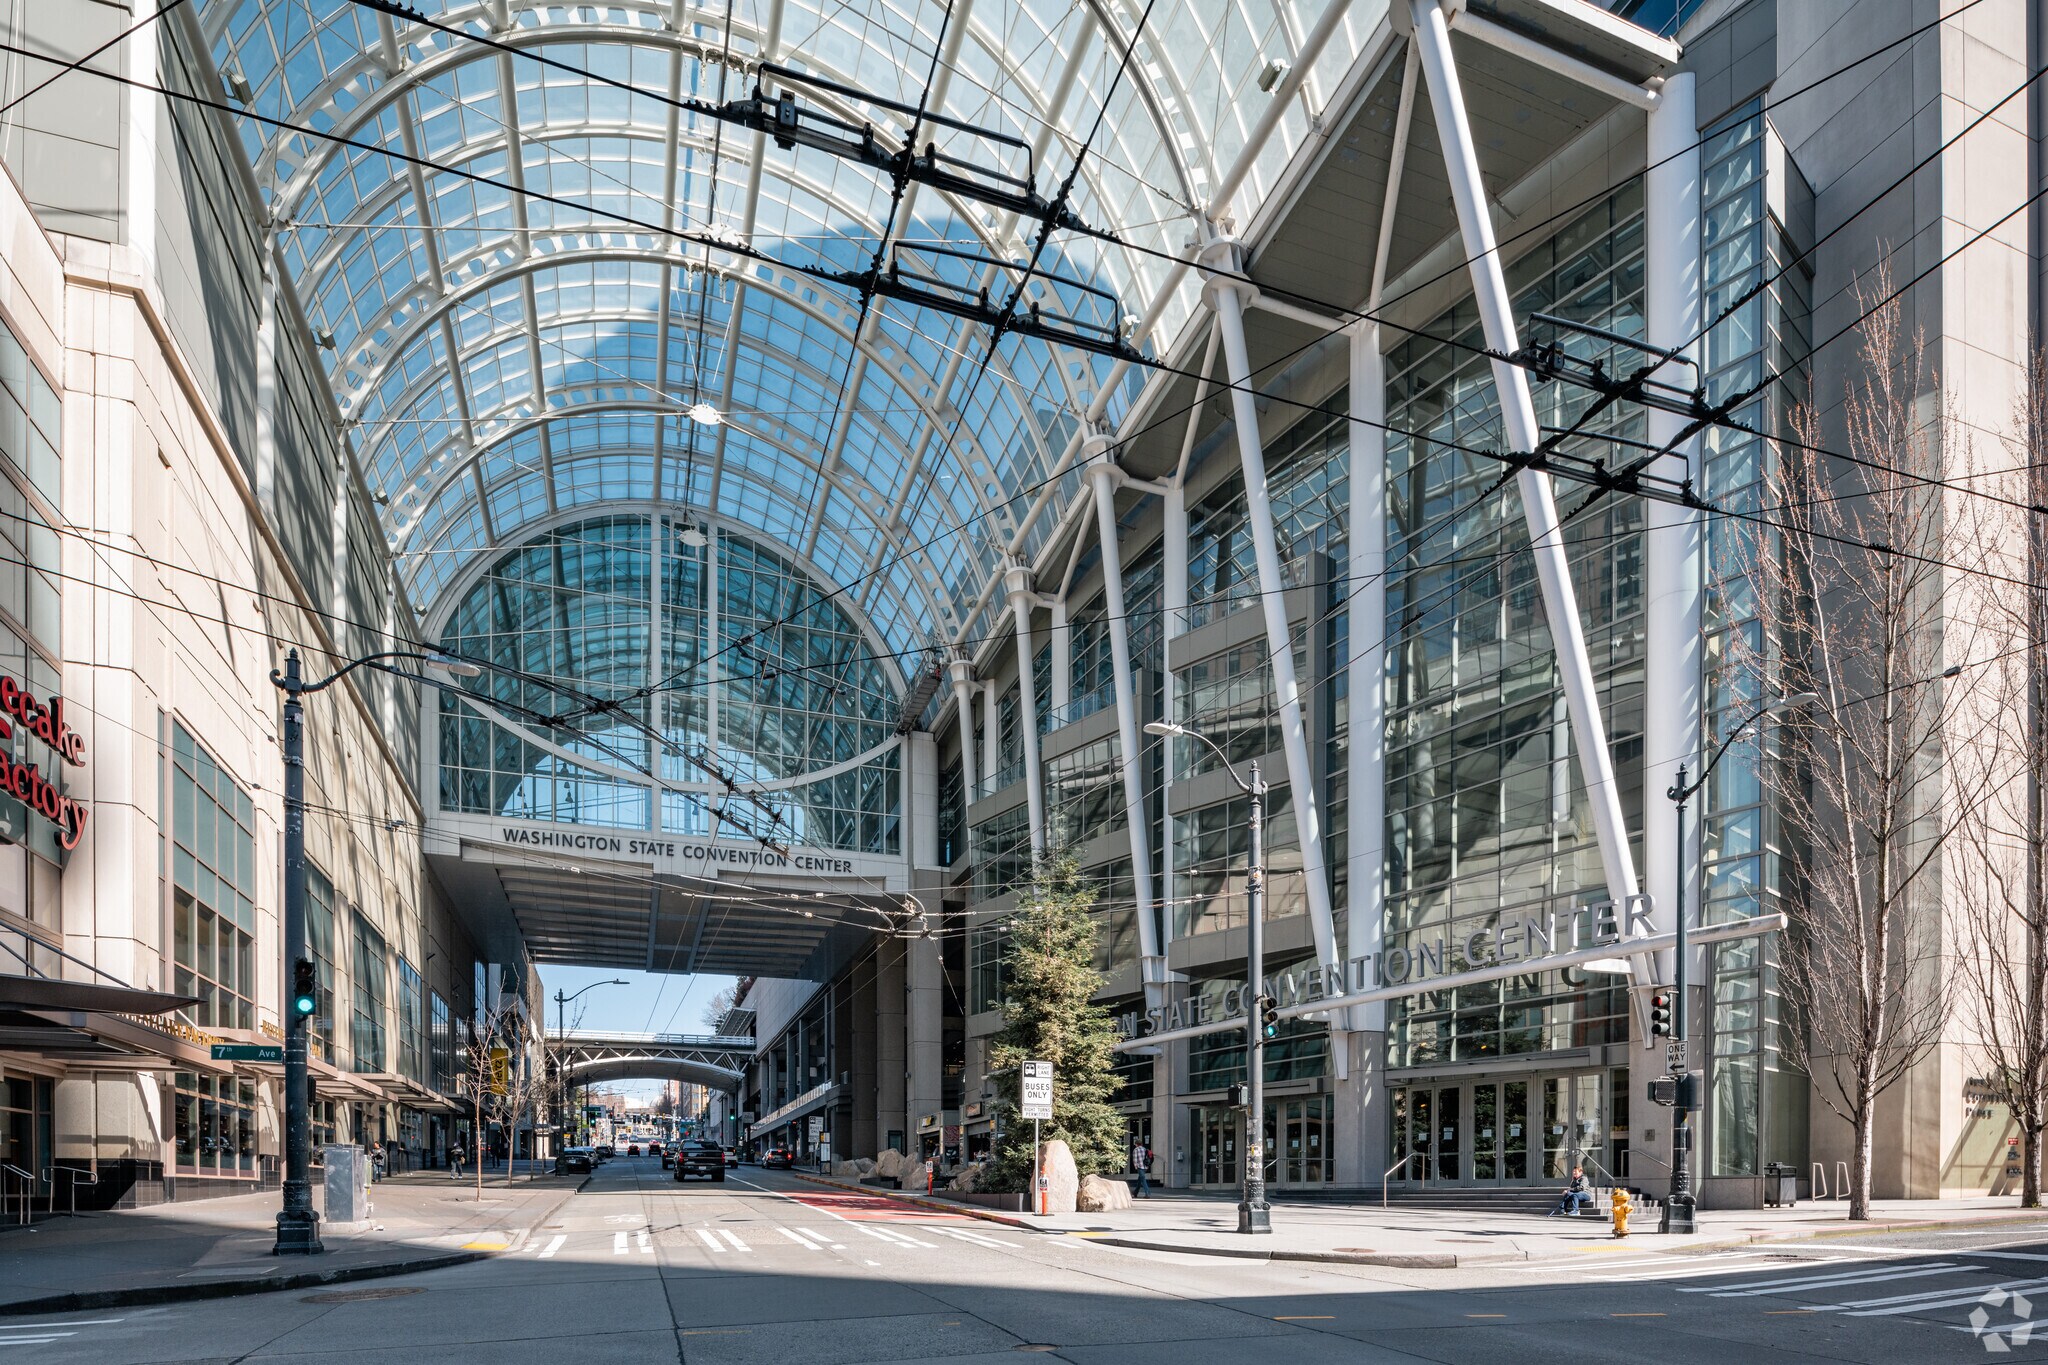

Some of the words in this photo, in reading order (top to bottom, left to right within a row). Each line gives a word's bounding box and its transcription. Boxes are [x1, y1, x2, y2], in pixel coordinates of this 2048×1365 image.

[502, 828, 621, 852] WASHINGTON
[629, 840, 675, 857] STATE
[682, 845, 787, 867] CONVENTION
[794, 856, 853, 874] CENTER
[1144, 993, 1213, 1036] STATE
[1463, 893, 1658, 968] CENTER
[214, 1046, 233, 1058] 7th
[258, 1049, 276, 1058] Ave
[1668, 1044, 1686, 1053] ONE
[1668, 1053, 1686, 1062] WAY
[1025, 1082, 1050, 1091] BUSES
[1027, 1091, 1047, 1099] ONLY
